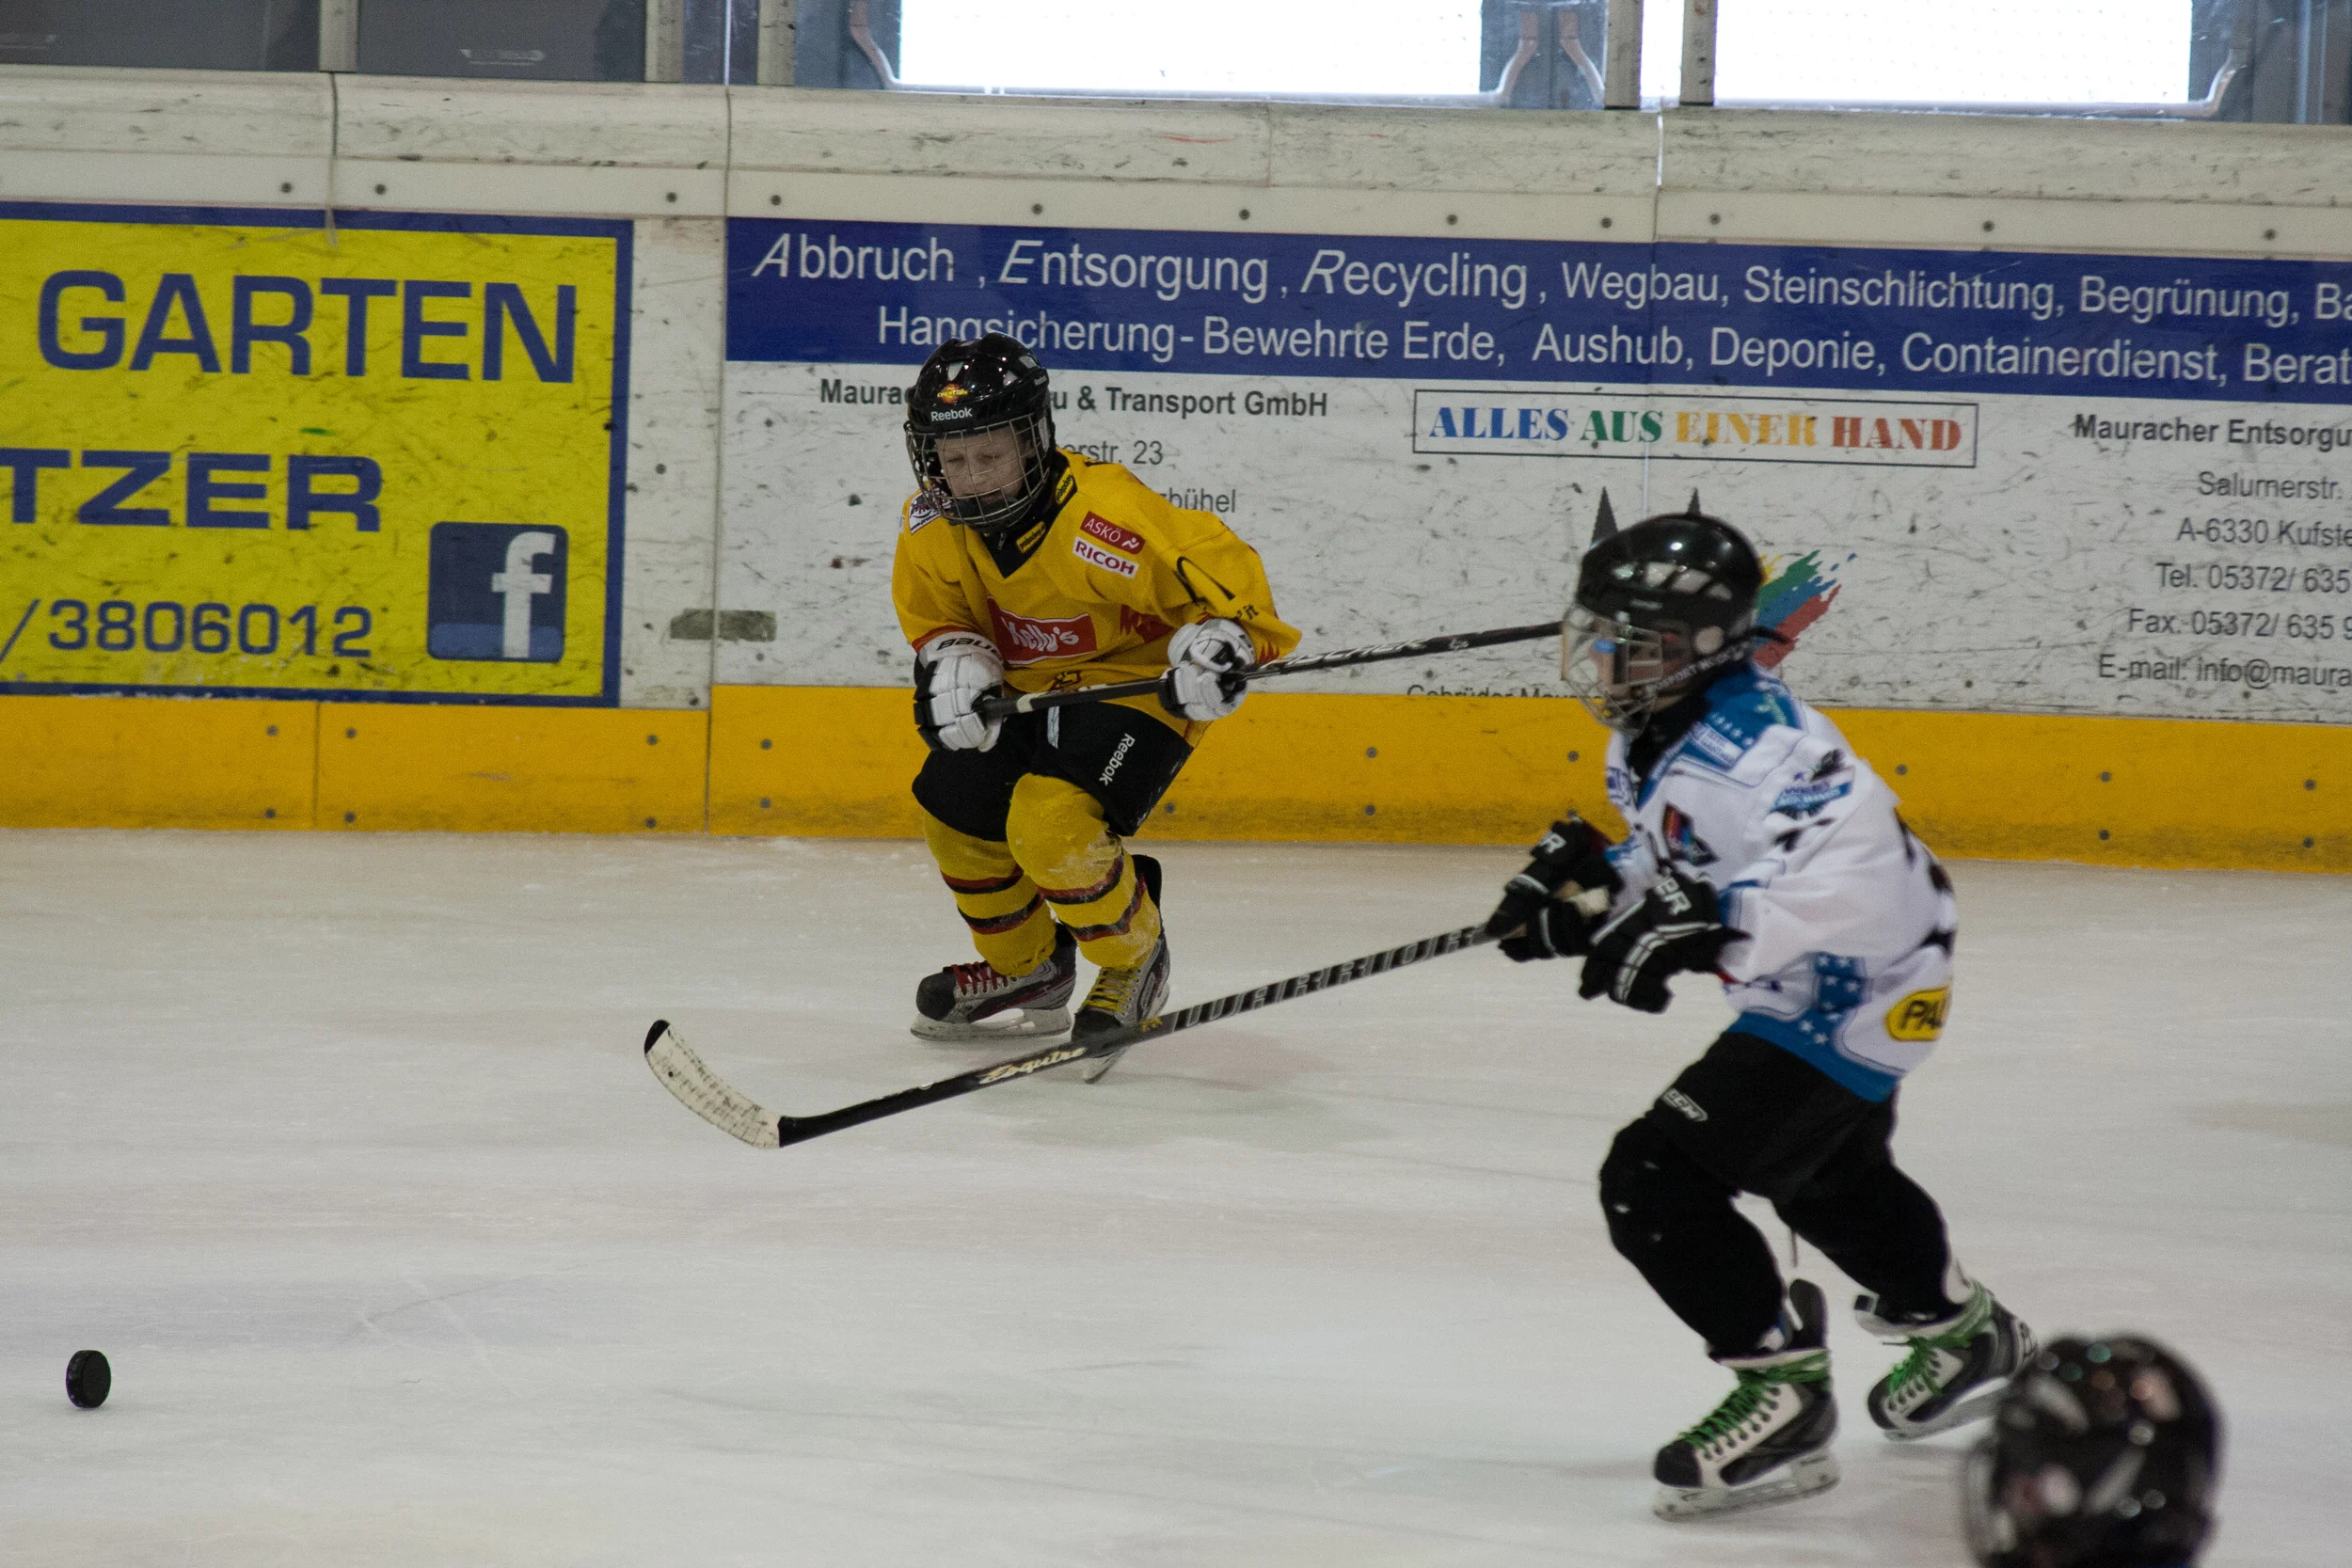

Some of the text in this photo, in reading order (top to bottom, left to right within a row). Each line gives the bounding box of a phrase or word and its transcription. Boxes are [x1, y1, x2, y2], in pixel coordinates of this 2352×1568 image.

[1562, 261, 1729, 309] Wegbau,
[1744, 265, 2065, 320] Steinschlichtung,
[2080, 273, 2299, 328] Begrünung,
[38, 269, 577, 384] GARTEN
[1404, 321, 1505, 366] Erde,
[1532, 324, 1693, 371] Aushub,
[1711, 327, 1885, 375] Deponie,
[1902, 332, 2227, 387] Containerdienst,
[2244, 344, 2352, 386] Berat
[820, 378, 911, 404] Maura
[1077, 386, 1096, 410] &
[1105, 387, 1235, 419] Transport
[1245, 391, 1327, 416] GmbH
[931, 407, 973, 421] Reebok
[1430, 406, 1963, 451] ALLES AUS EINER HAND
[2074, 414, 2352, 452] Mauracher Entsorgu
[1133, 440, 1164, 465] 23
[0, 447, 382, 532] TZER
[1159, 487, 1235, 513] bühel
[1085, 518, 1121, 543] ASKÖ
[2176, 518, 2352, 547] A-6330 Kufste
[1075, 540, 1136, 575] RICOH
[2208, 565, 2296, 592] 05372/
[2303, 567, 2350, 594] 635
[1001, 616, 1079, 652] Kelly's
[2191, 611, 2280, 638] 05372/
[2287, 613, 2334, 640] 635
[2197, 657, 2352, 689] info@maura
[1099, 734, 1136, 786] Reebok
